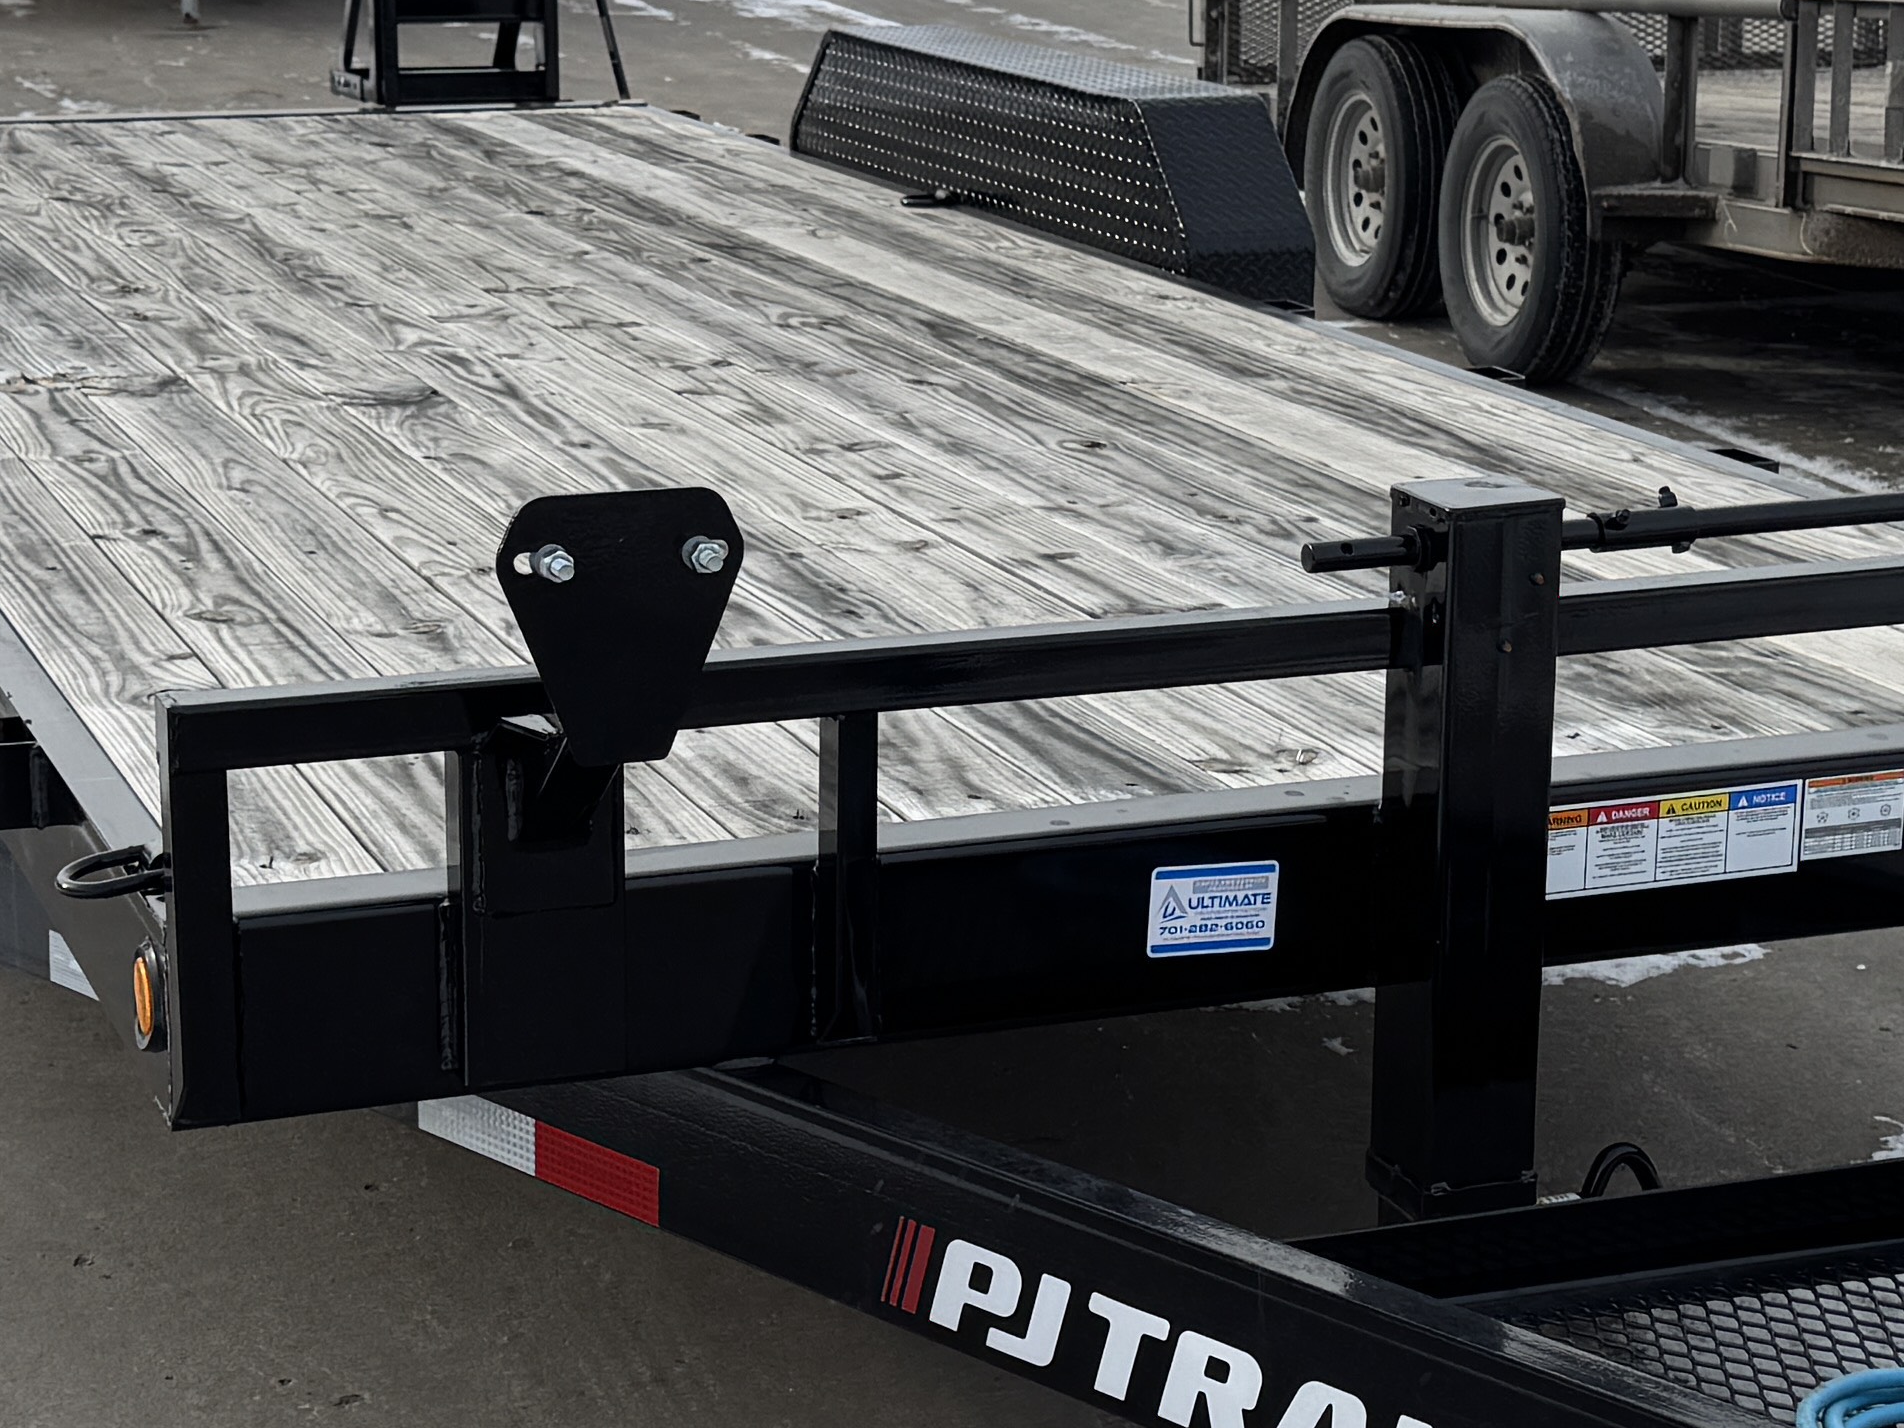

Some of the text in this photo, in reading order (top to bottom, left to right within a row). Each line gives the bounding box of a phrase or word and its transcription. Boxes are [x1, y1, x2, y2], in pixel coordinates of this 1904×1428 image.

[1753, 792, 1786, 804] NOTICE
[1681, 799, 1723, 812] CAUTION
[1549, 814, 1582, 826] RNING
[1612, 807, 1650, 820] DANGER
[1188, 892, 1272, 910] ULTIMATE
[929, 1238, 1071, 1369] PJ
